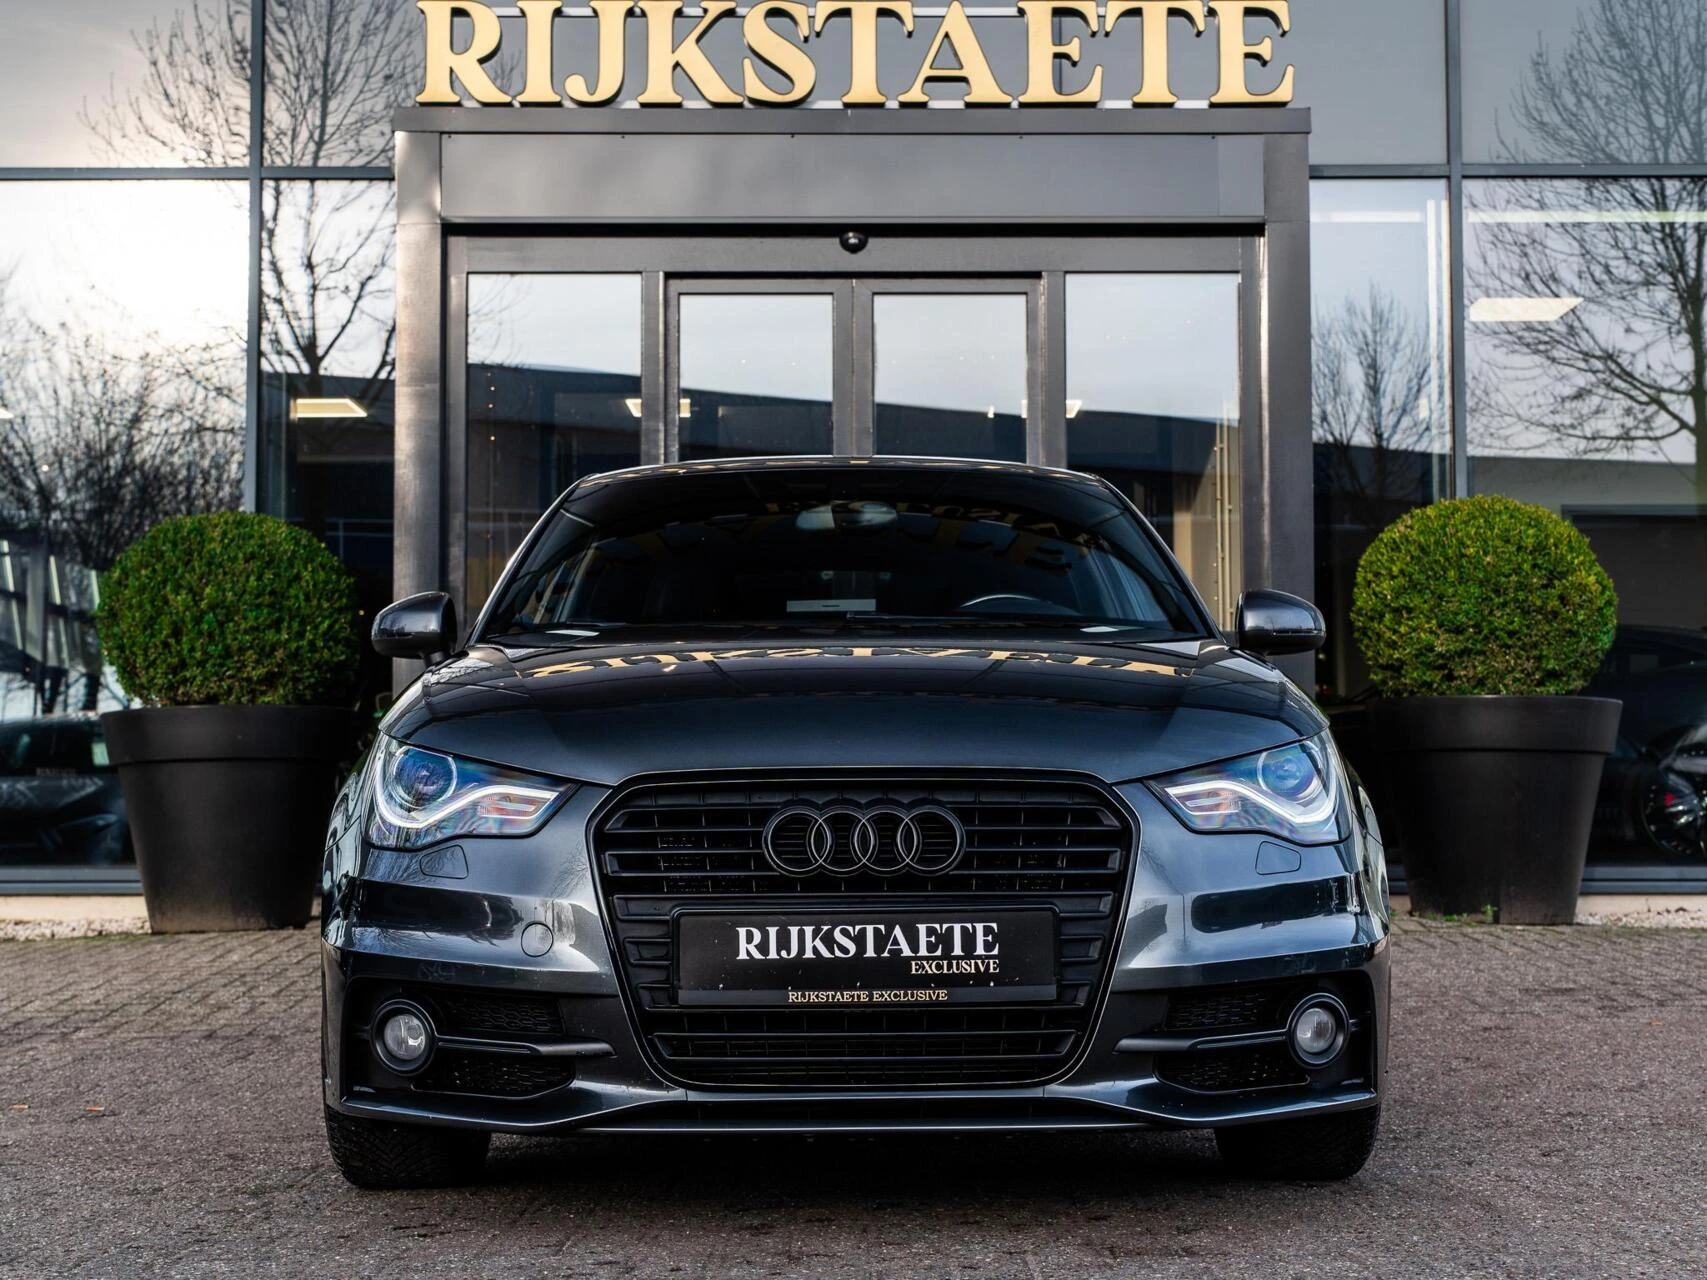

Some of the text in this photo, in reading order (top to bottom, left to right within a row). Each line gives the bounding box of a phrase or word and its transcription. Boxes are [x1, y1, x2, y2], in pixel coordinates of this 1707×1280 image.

[416, 0, 1295, 106] RIJKSTAETE
[735, 922, 999, 960] RIJKSTAETE
[910, 960, 999, 974] EXCLUSIVE
[787, 989, 948, 1003] RIJKSTAETE EXCLUSIVE
